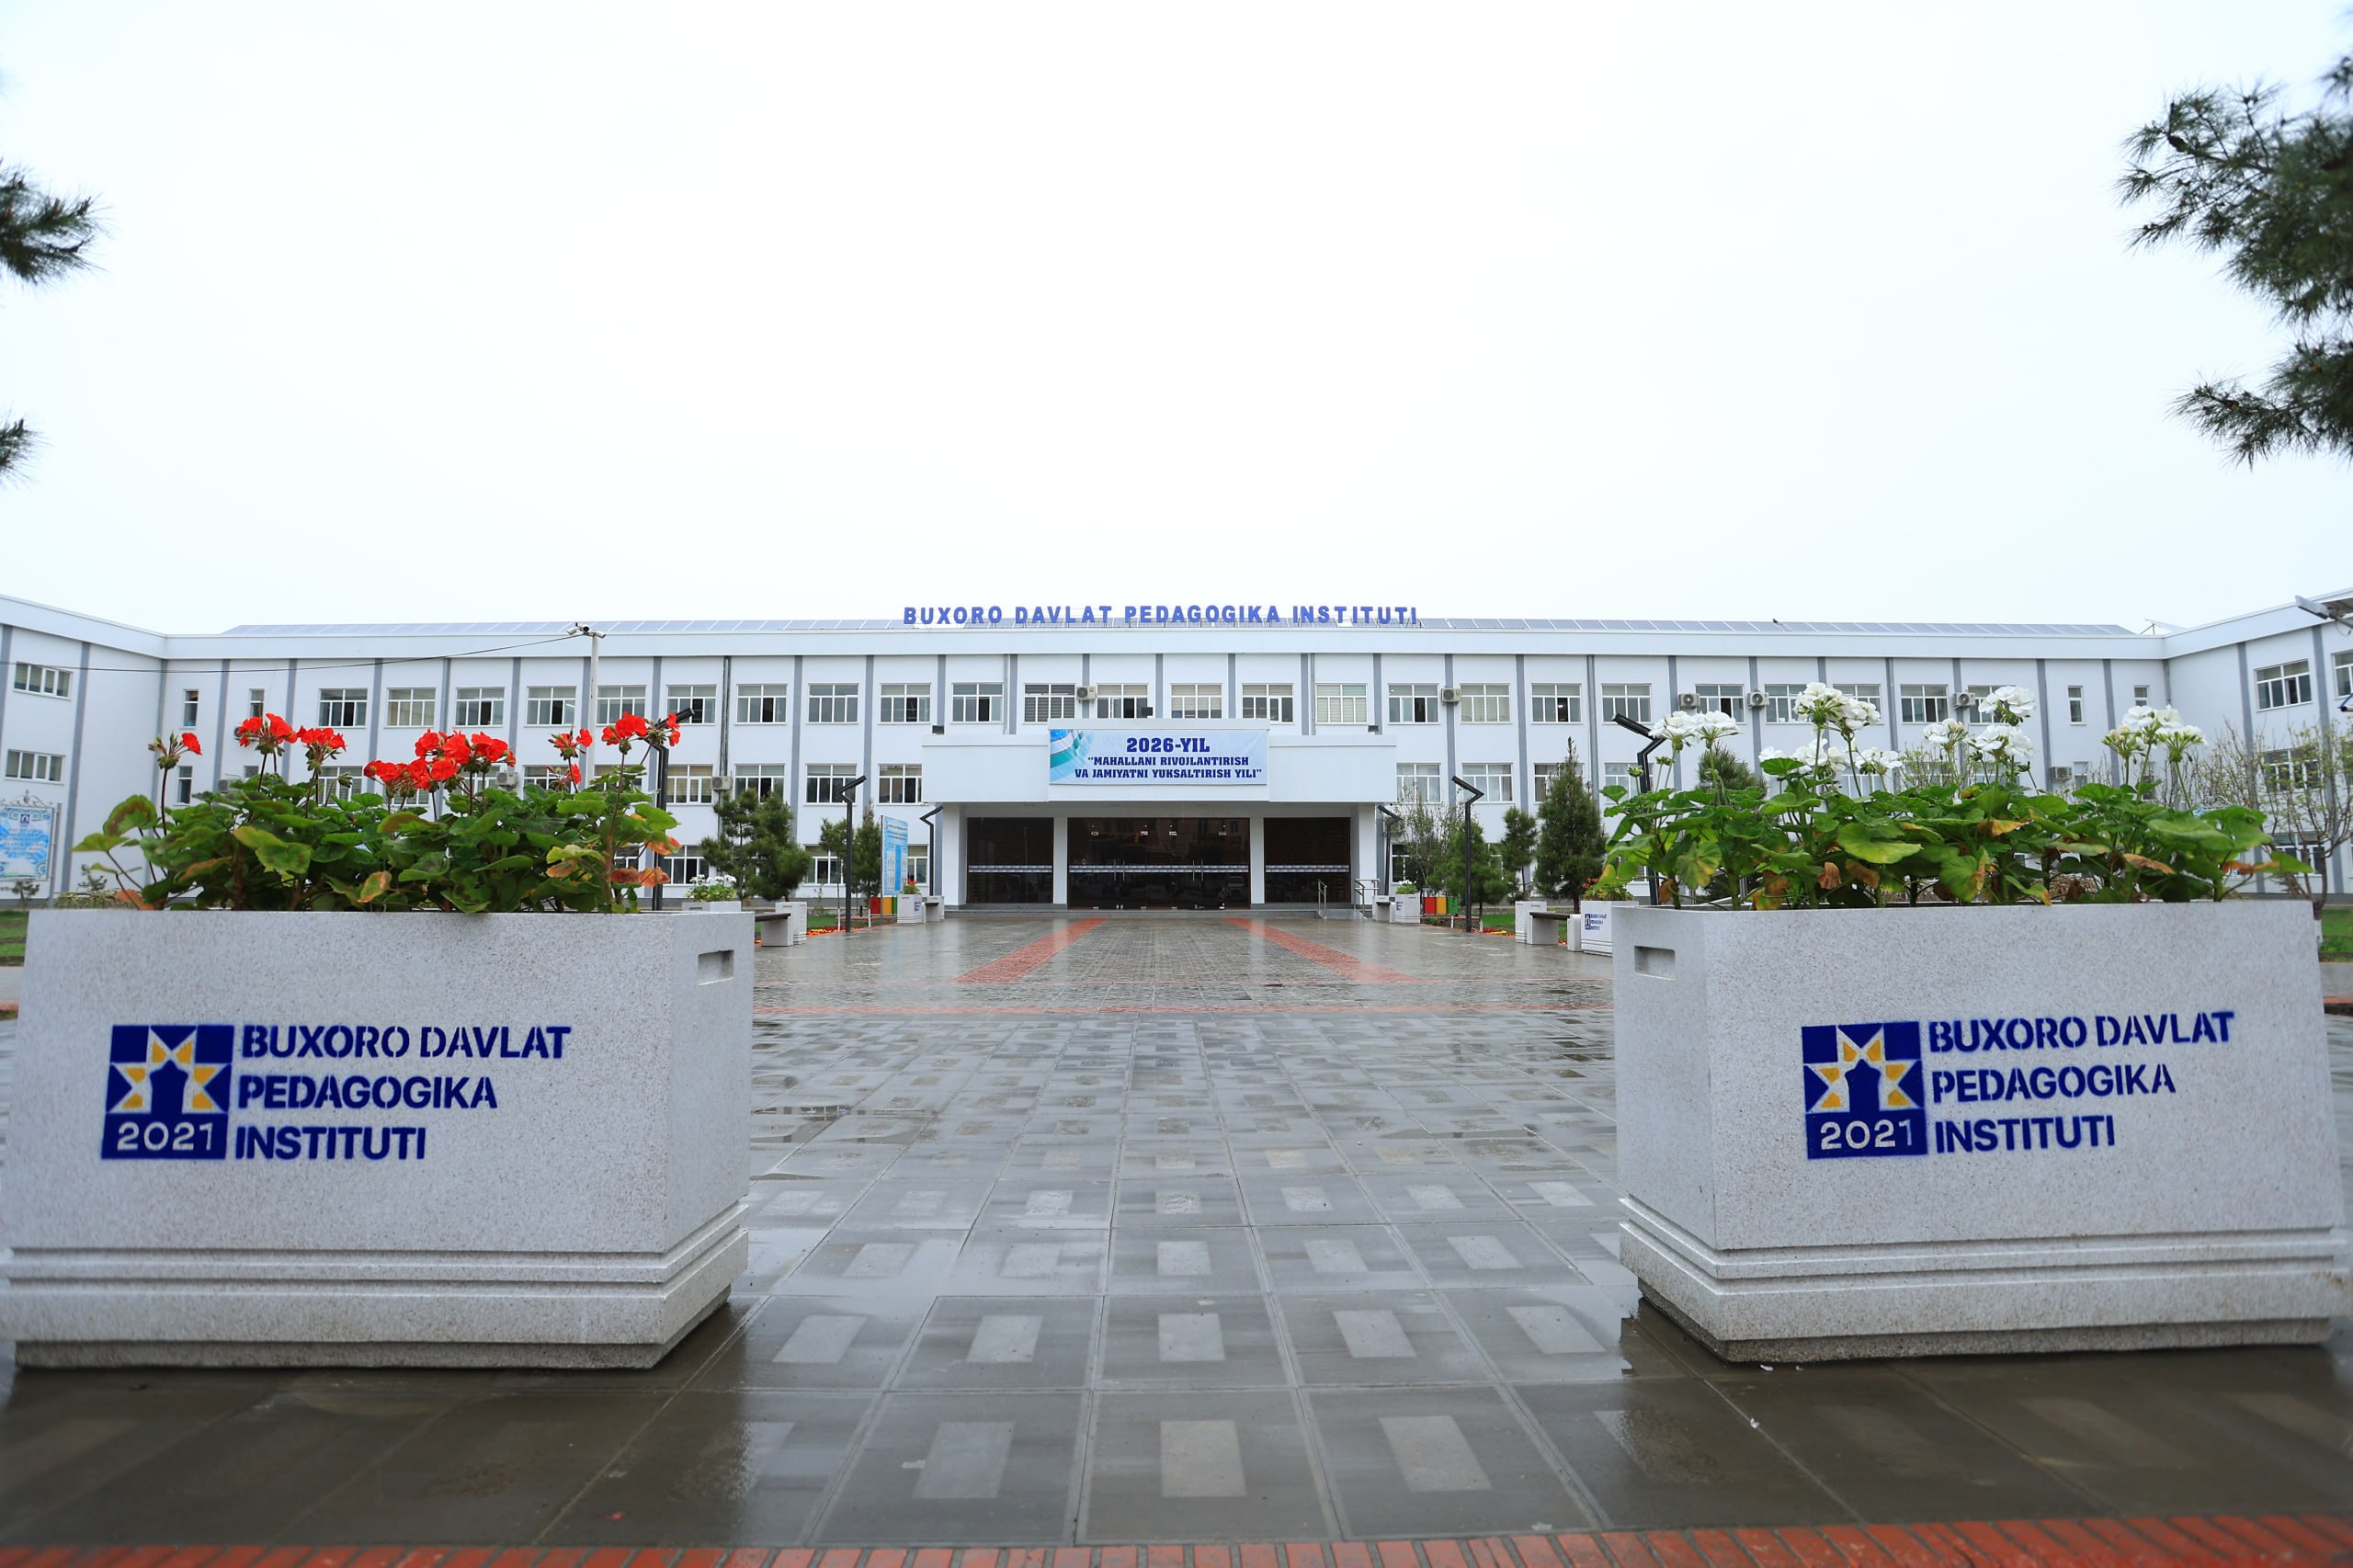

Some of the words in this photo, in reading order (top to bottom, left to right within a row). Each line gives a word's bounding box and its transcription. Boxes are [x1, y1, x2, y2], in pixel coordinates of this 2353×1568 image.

[904, 606, 1003, 625] BUXORO
[1015, 606, 1112, 625] DAVLAT
[1124, 605, 1280, 625] PEDAGOGIKA
[1292, 606, 1417, 625] INSTITUTI
[1087, 756, 1157, 767] “MAHALLANI
[1160, 756, 1249, 767] RIVOJLANTIRISH
[1126, 737, 1211, 753] 2026-YIL
[1074, 768, 1089, 778] VA
[1092, 768, 1149, 778] JAMIYATNI
[1152, 768, 1232, 778] YUKSALTIRISH
[1234, 768, 1262, 778] YILI”
[242, 1025, 409, 1059] BUXORO
[419, 1025, 572, 1059] DAVLAT
[1929, 1017, 2087, 1052] BUXORO
[2095, 1011, 2235, 1047] DAVLAT
[237, 1074, 498, 1110] PEDAGOGIKA
[1932, 1062, 2177, 1103] PEDAGOGIKA
[116, 1120, 214, 1152] 2021
[234, 1125, 426, 1161] INSTITUTI
[1819, 1119, 1914, 1151] 2021
[1935, 1115, 2116, 1154] INSTITUTI
